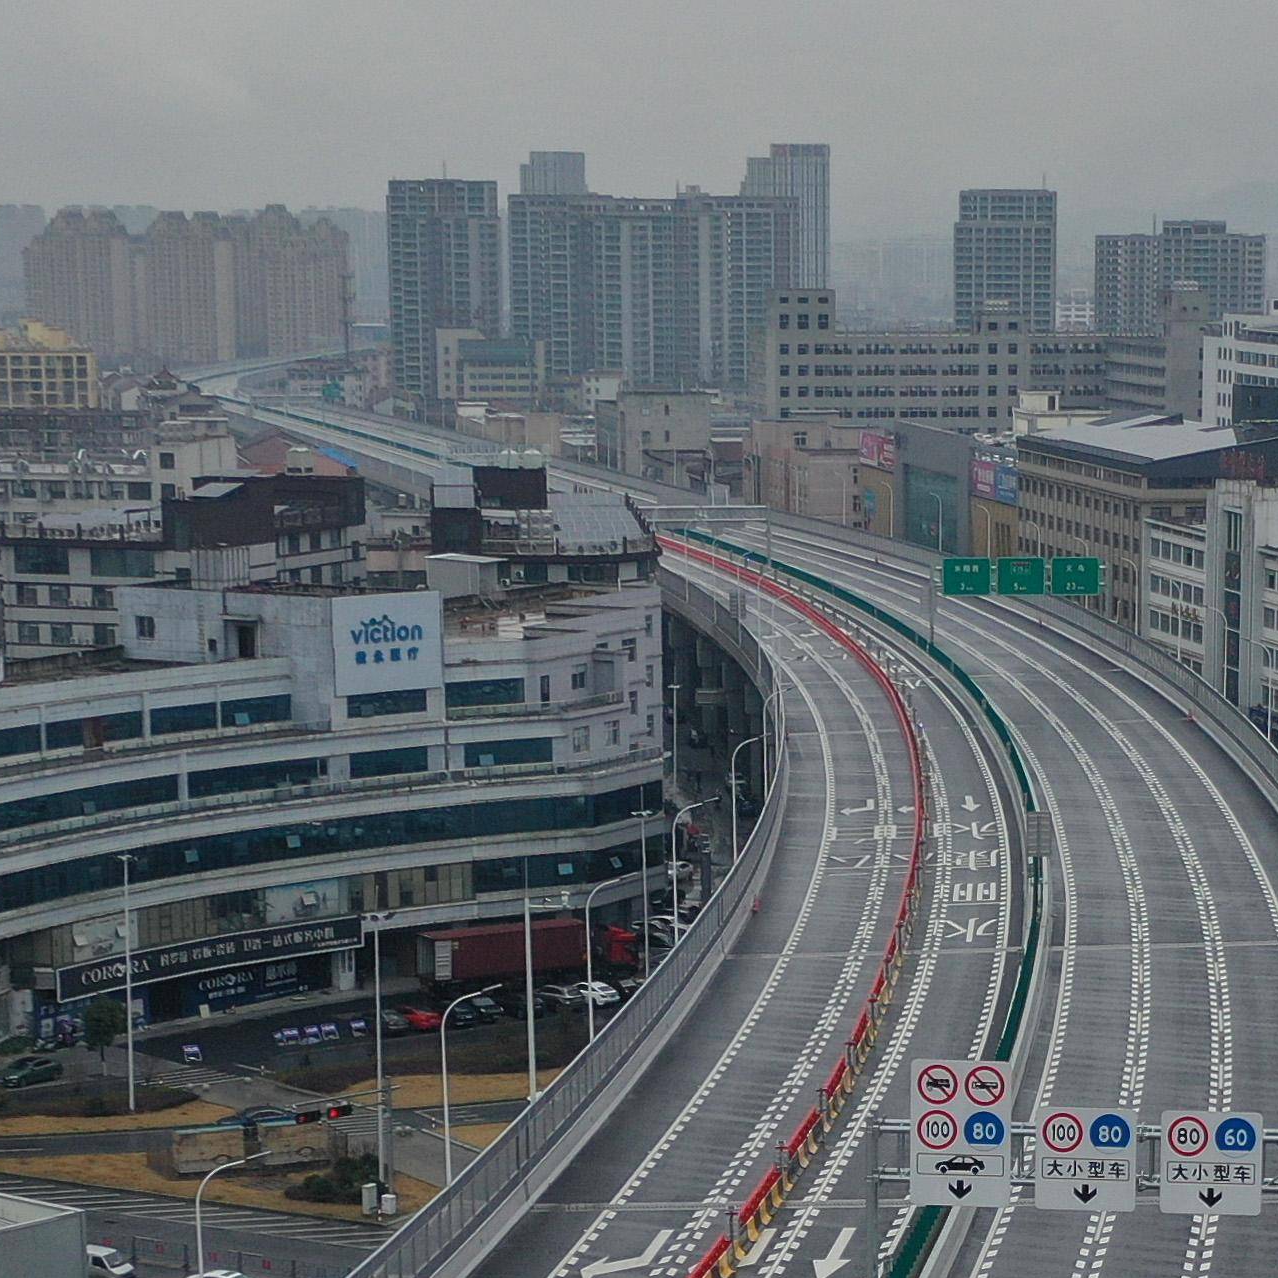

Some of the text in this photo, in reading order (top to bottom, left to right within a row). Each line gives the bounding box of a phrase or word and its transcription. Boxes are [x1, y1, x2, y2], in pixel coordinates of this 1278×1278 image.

[925, 1121, 950, 1140] 100
[972, 1121, 996, 1140] 80
[1051, 1123, 1076, 1142] 100
[1098, 1124, 1122, 1143] 80
[1176, 1127, 1200, 1146] 80
[1223, 1128, 1248, 1147] 60
[1046, 1159, 1126, 1180] 大小型车
[1171, 1163, 1252, 1184] 大小型车
